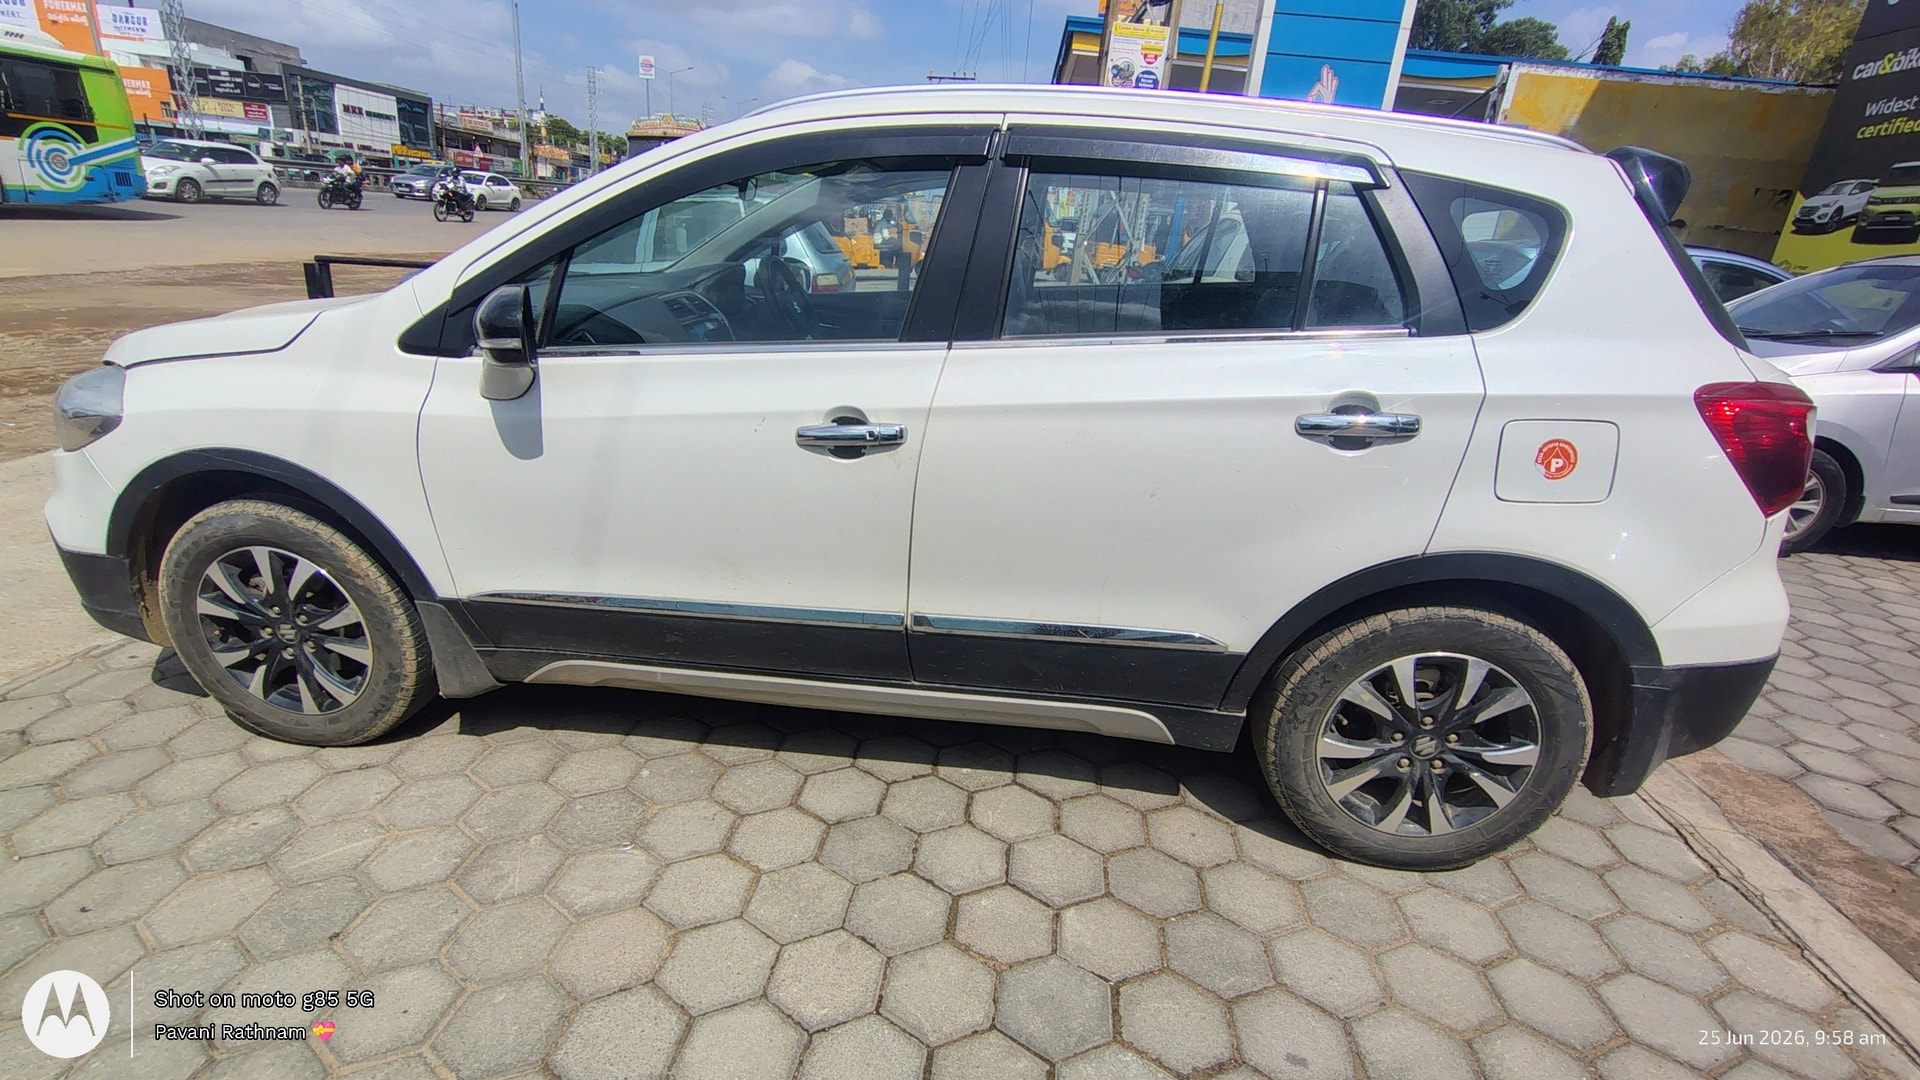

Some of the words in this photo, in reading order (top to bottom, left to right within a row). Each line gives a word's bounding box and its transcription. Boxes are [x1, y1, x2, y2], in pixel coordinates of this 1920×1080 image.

[342, 104, 364, 117] MRR
[1865, 96, 1919, 116] Widest
[1551, 458, 1564, 472] P
